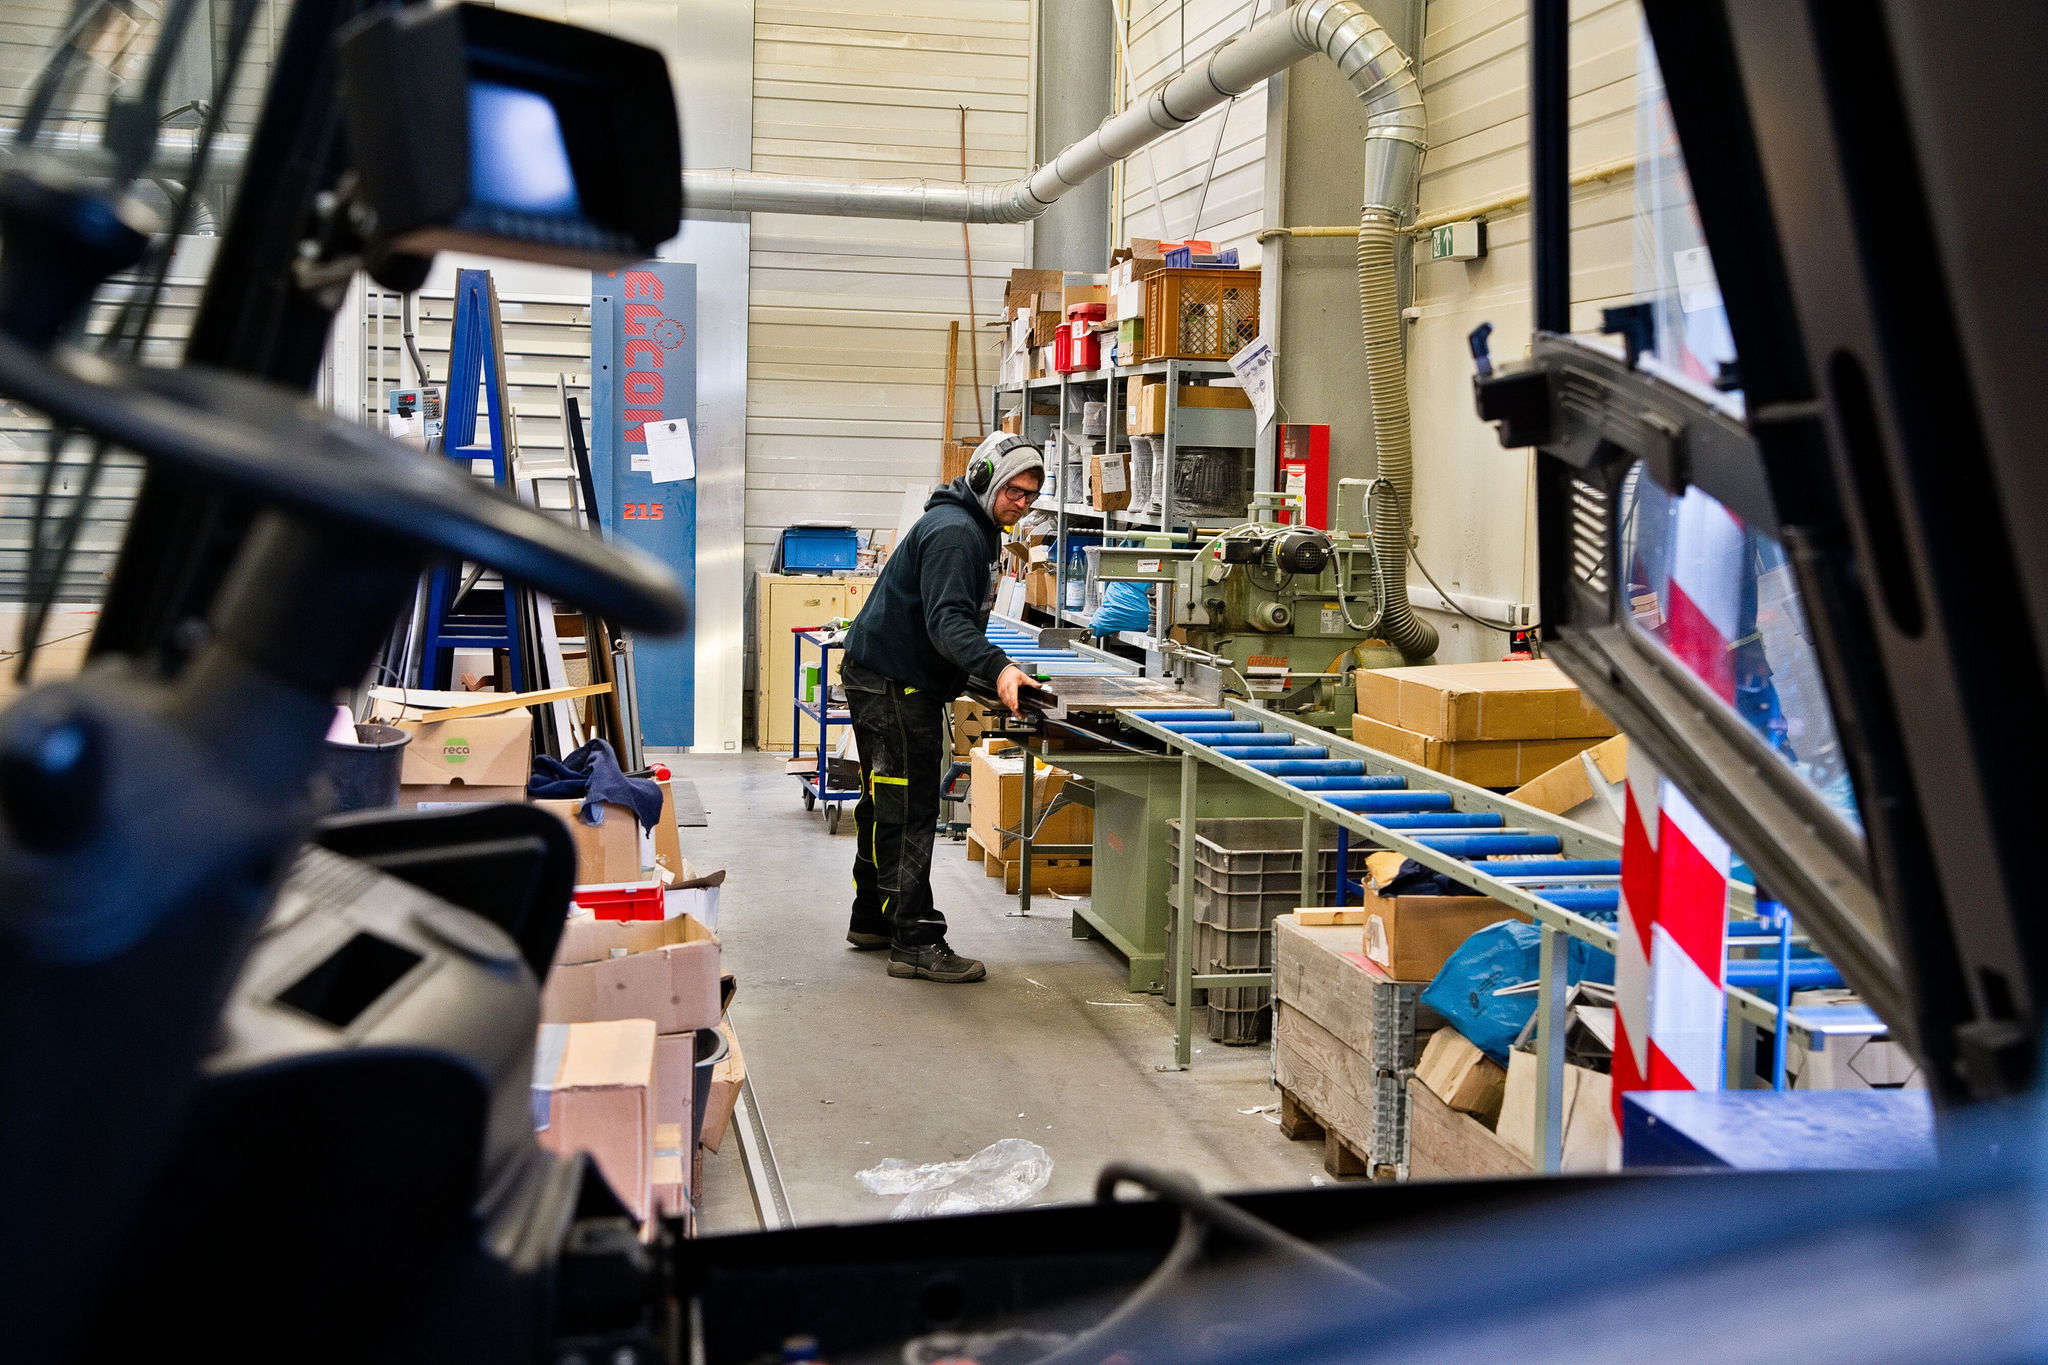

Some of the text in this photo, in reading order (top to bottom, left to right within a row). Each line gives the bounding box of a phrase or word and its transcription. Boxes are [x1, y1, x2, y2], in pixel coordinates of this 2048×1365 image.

[624, 270, 664, 442] ELCON
[624, 503, 664, 519] 215
[850, 586, 857, 595] 6
[1247, 655, 1288, 667] GRAULE
[443, 747, 470, 755] reca
